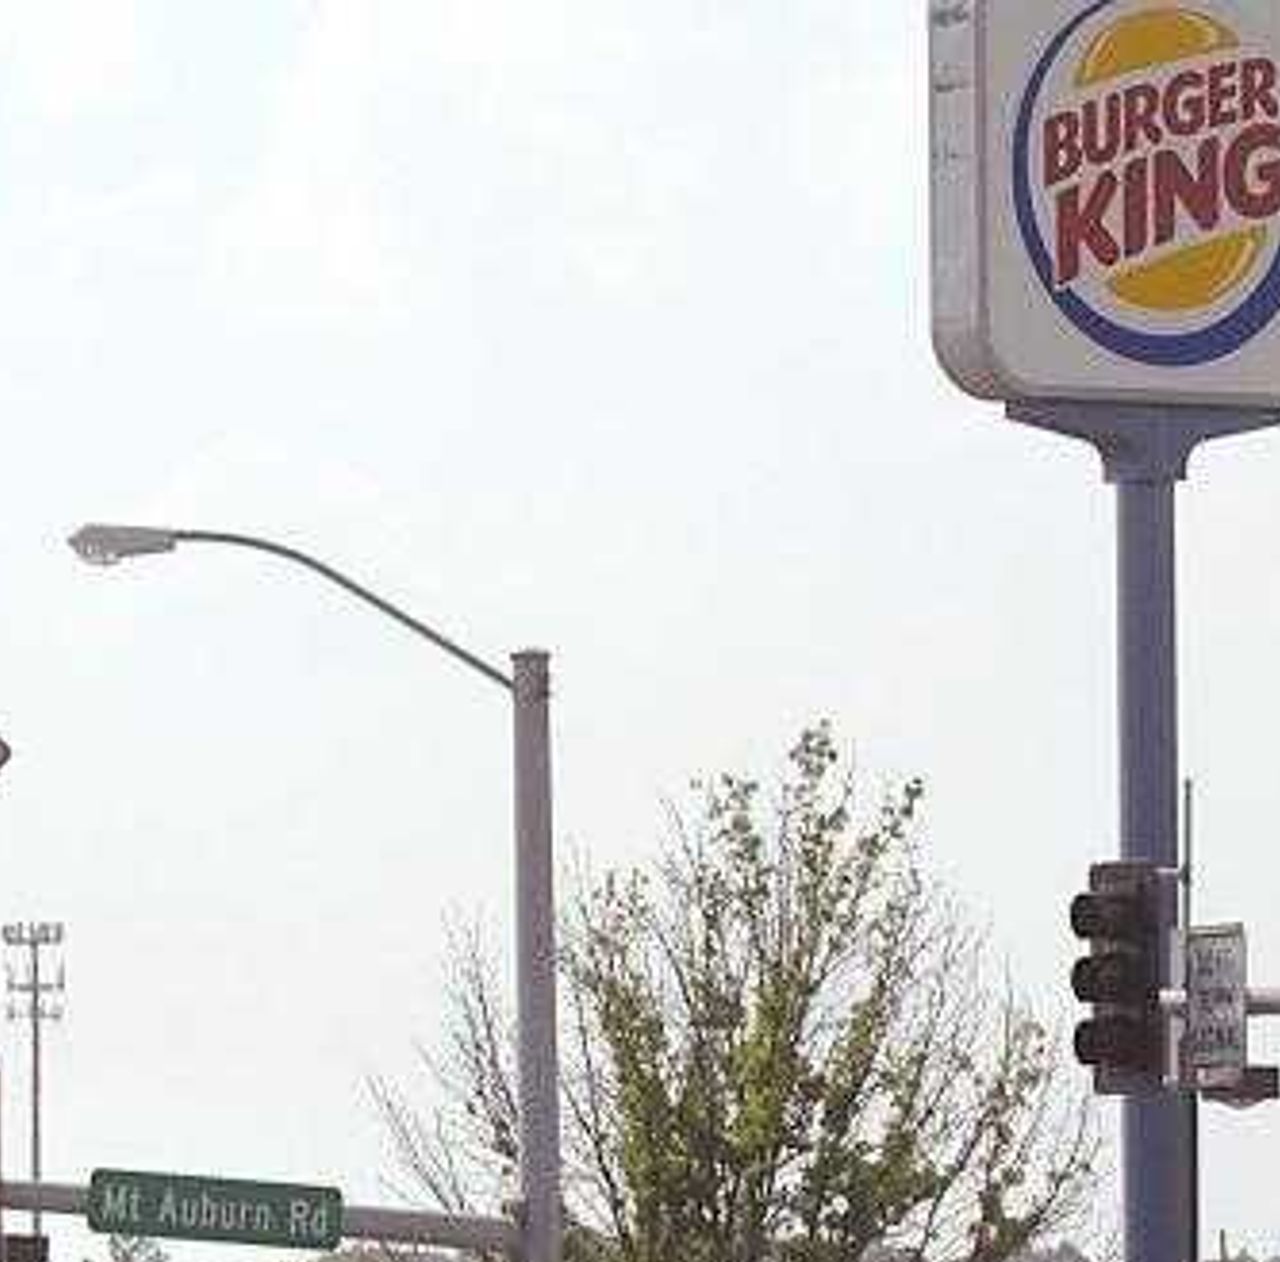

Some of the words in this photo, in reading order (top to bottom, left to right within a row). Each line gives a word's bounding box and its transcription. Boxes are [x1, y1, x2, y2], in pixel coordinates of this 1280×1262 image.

[1042, 57, 1279, 187] BURGER
[101, 1181, 141, 1223] Mt
[158, 1186, 271, 1232] Auburn
[289, 1199, 328, 1238] Rd
